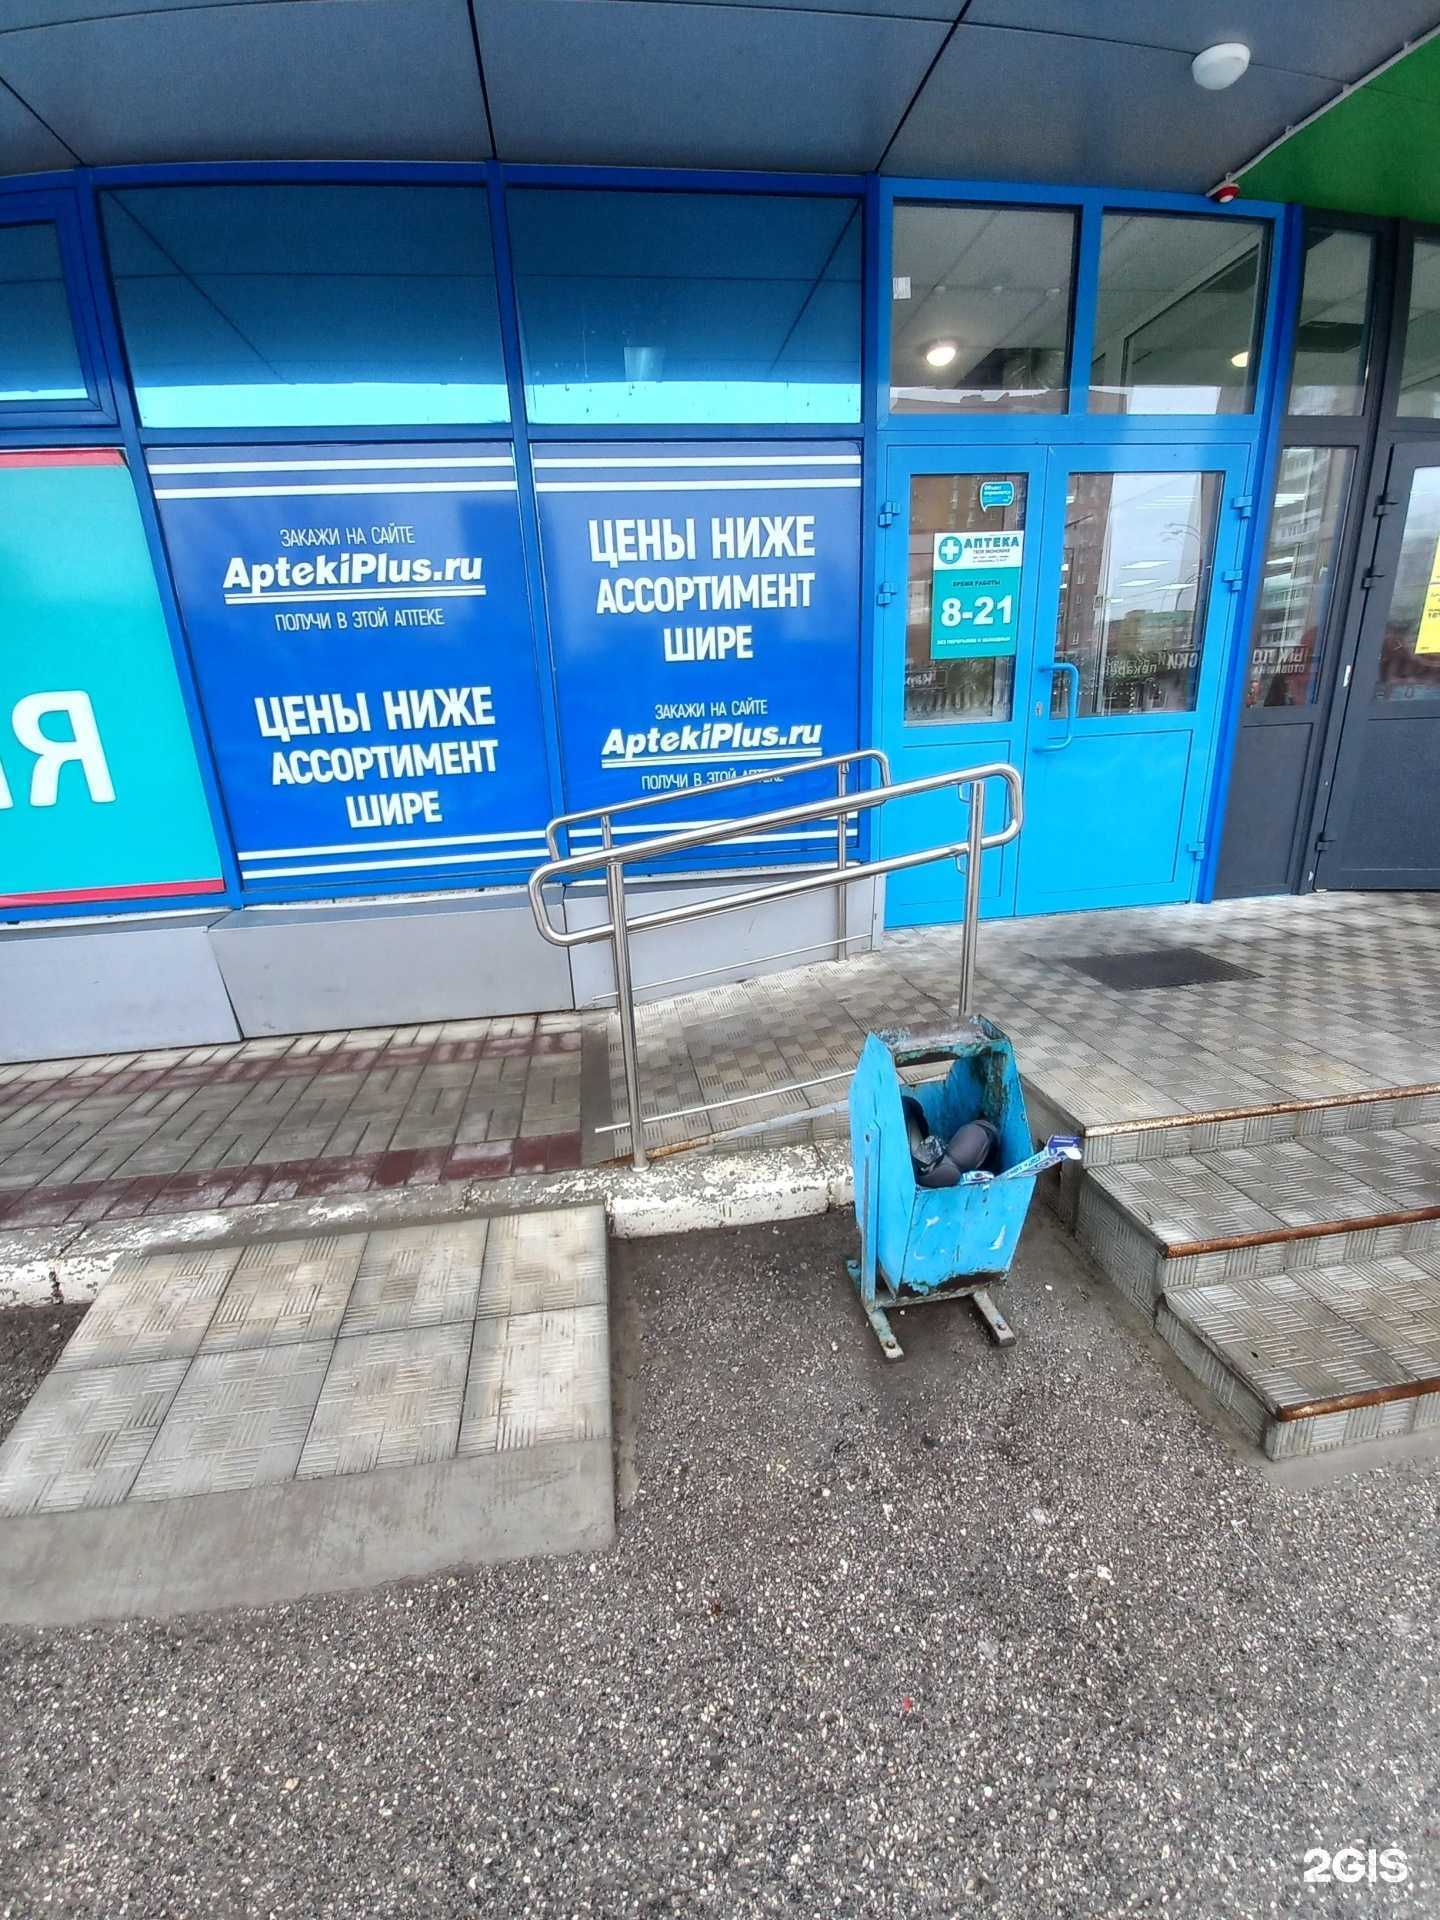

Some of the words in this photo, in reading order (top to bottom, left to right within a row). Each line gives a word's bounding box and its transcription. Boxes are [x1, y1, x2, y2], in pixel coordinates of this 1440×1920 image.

[280, 527, 341, 547] ЗАКАЖИ
[345, 527, 367, 545] НА
[370, 523, 416, 545] САЙТЕ
[588, 517, 696, 568] ЦЕНЫ
[711, 515, 816, 560] НИЖЕ
[963, 536, 1020, 549] АПТЕКА
[223, 552, 484, 594] AptekiPlus.ru
[596, 572, 816, 615] АССОРТИМЕНТ
[941, 595, 1012, 627] 8-21
[275, 612, 332, 631] ПОЛУЧИ
[336, 611, 348, 629] В
[351, 607, 389, 628] ЭТОЙ
[394, 607, 445, 626] АПТЕКЕ
[663, 625, 753, 663] ШИРЕ
[254, 691, 371, 742] ЦЕНЫ
[382, 686, 496, 731] НИЖЕ
[655, 703, 706, 720] ЗАКАЖИ
[710, 702, 727, 717] НА
[731, 697, 768, 716] САЙТЕ
[0, 690, 117, 808] Я
[602, 722, 822, 760] AptekiPlus.ru
[271, 739, 499, 786] АССОРТИМЕНТ
[641, 774, 689, 791] ПОЛУЧИ
[693, 772, 702, 787] В
[345, 790, 443, 829] ШИРЕ
